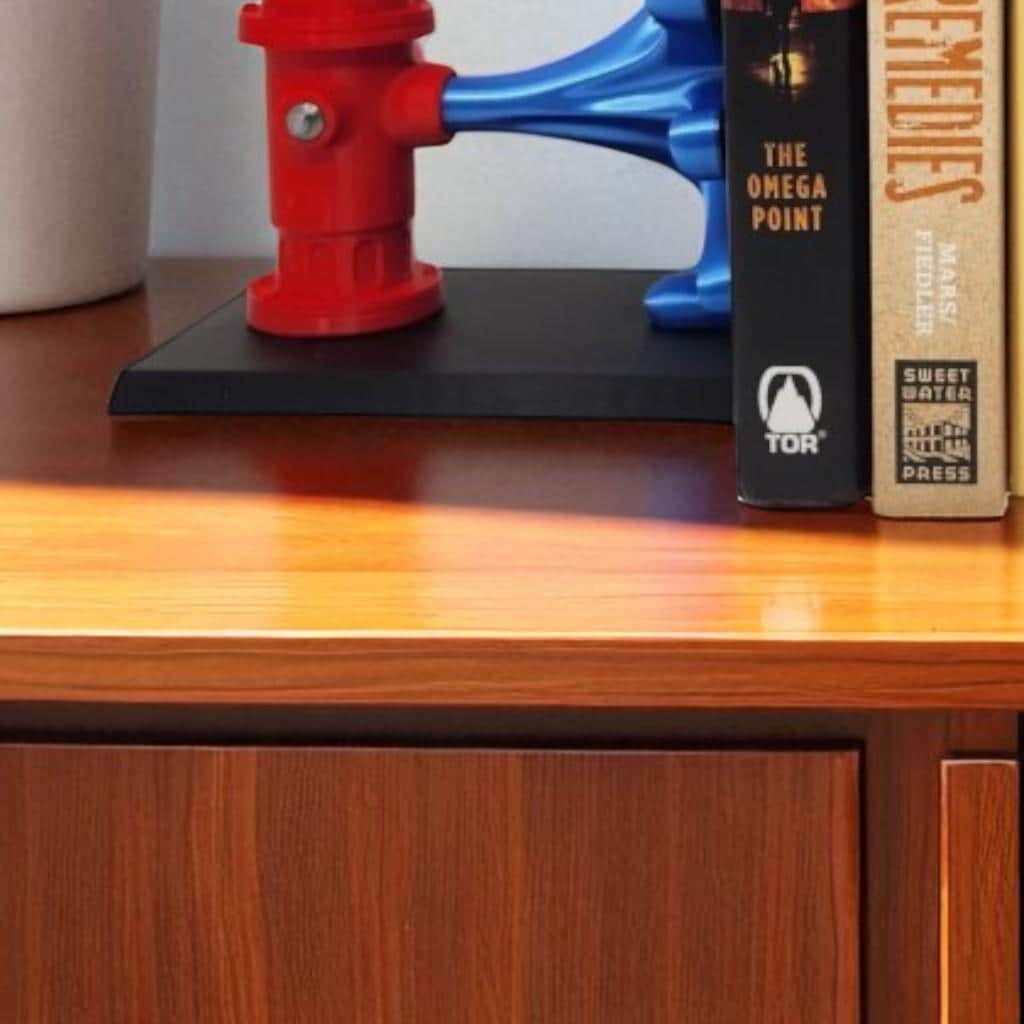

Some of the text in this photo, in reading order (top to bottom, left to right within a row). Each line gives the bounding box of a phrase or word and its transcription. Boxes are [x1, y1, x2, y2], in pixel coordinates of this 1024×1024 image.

[763, 141, 809, 169] THE
[746, 172, 828, 200] OMEGA
[751, 205, 823, 232] POINT
[903, 367, 970, 384] SWEET
[901, 384, 973, 402] WATER
[902, 465, 971, 482] PRESS
